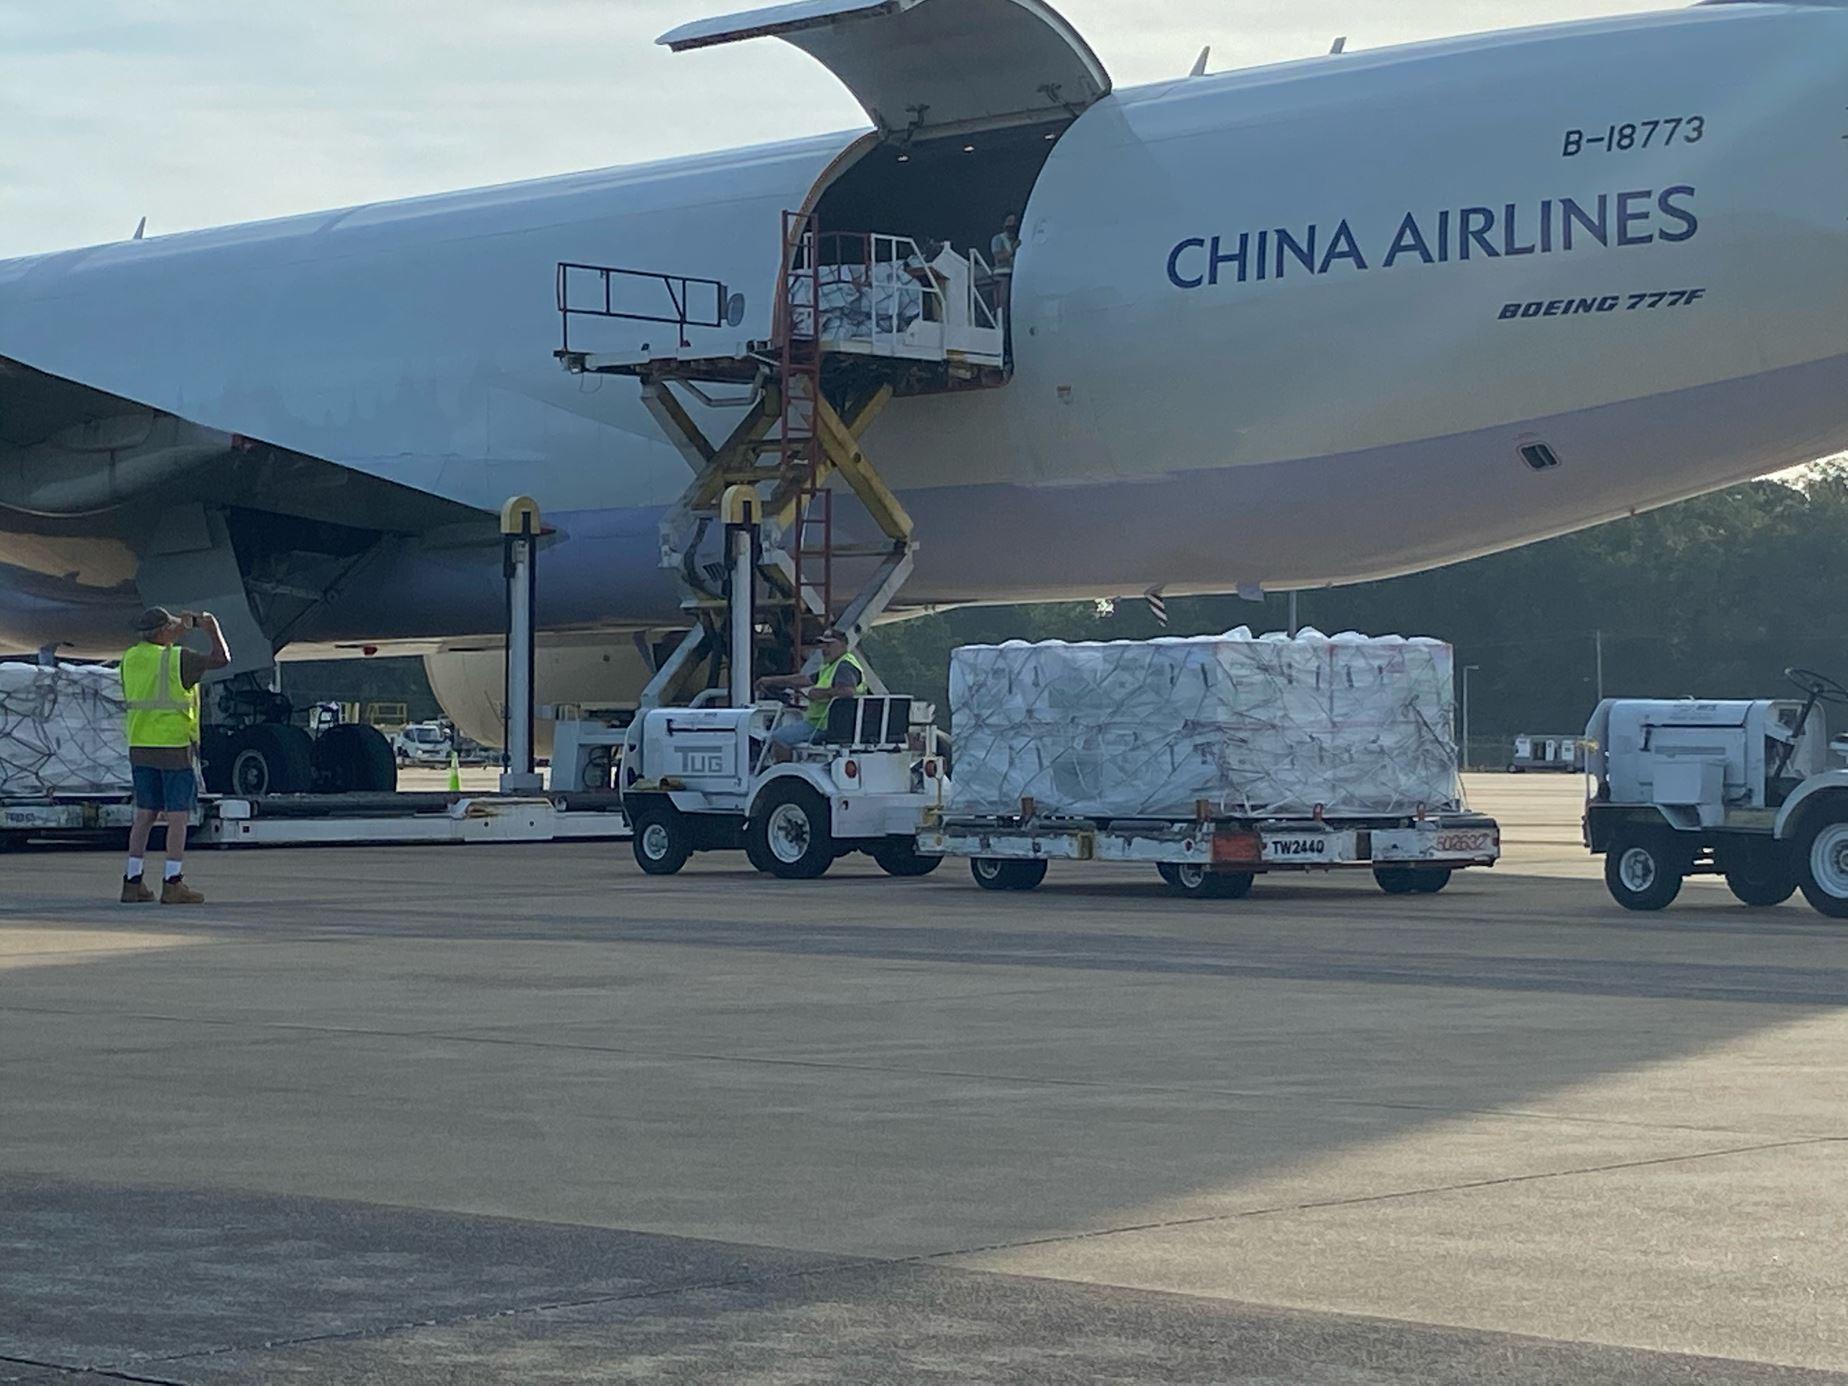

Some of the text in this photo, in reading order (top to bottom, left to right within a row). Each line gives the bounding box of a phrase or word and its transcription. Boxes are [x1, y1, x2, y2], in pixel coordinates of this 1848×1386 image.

[1562, 116, 1705, 157] B-18773
[1166, 185, 1698, 289] CHINA AIRLINES
[1497, 288, 1706, 320] BOEING 777F
[674, 746, 723, 773] TUG
[1271, 839, 1325, 855] TW2440
